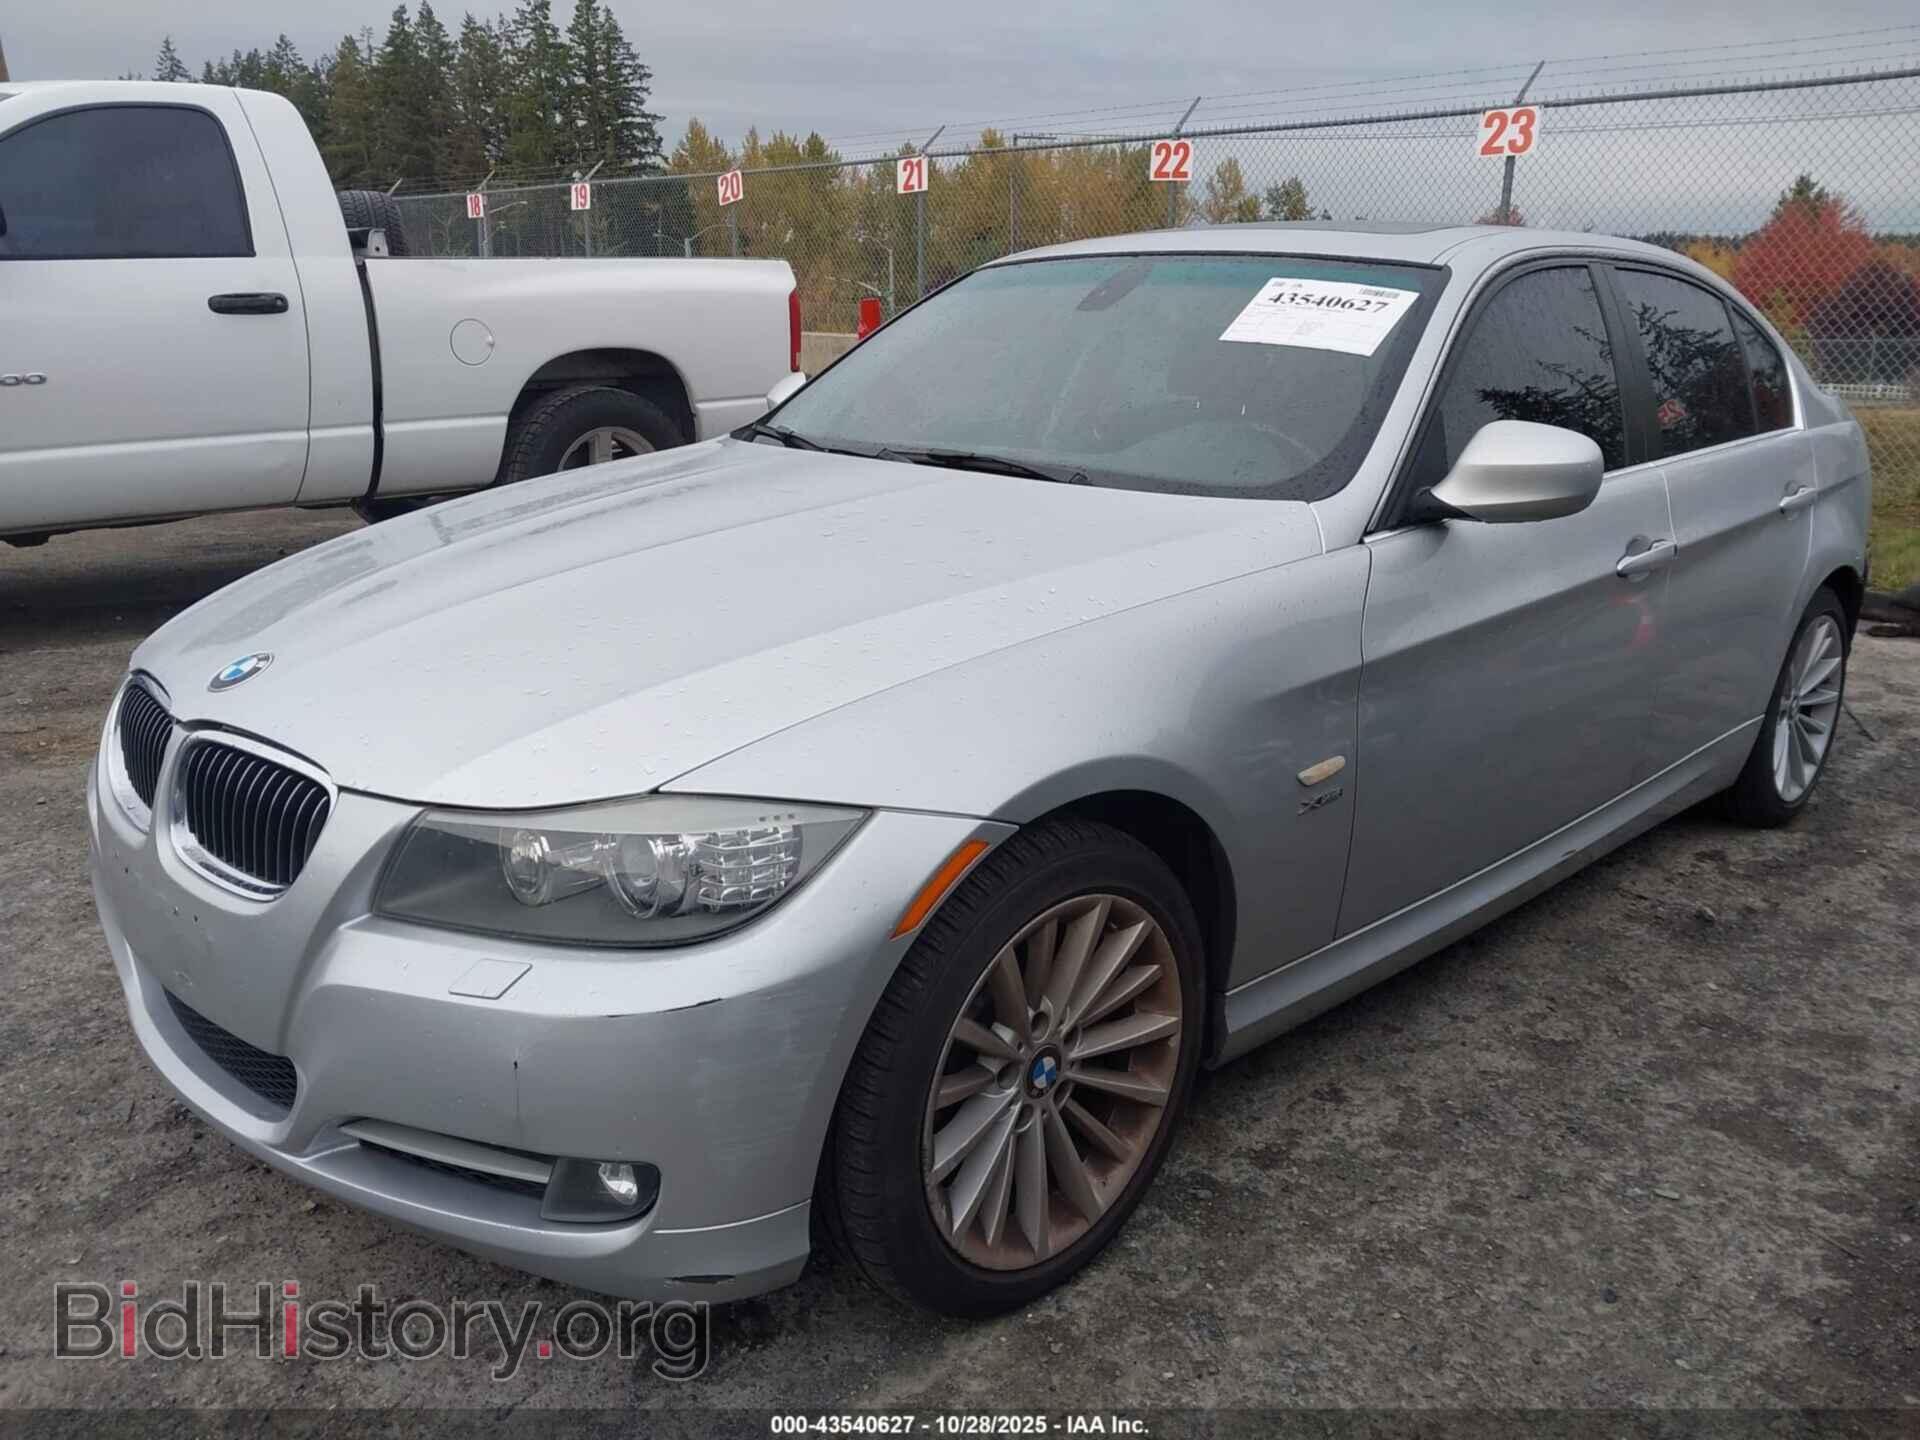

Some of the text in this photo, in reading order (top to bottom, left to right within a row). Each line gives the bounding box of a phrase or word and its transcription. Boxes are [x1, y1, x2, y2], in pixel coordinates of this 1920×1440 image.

[1480, 109, 1537, 156] 23
[902, 157, 923, 190] 21
[1154, 142, 1190, 179] 22
[574, 184, 588, 208] 19
[720, 171, 740, 204] 20
[468, 195, 482, 217] 18
[1268, 291, 1390, 314] 43540627
